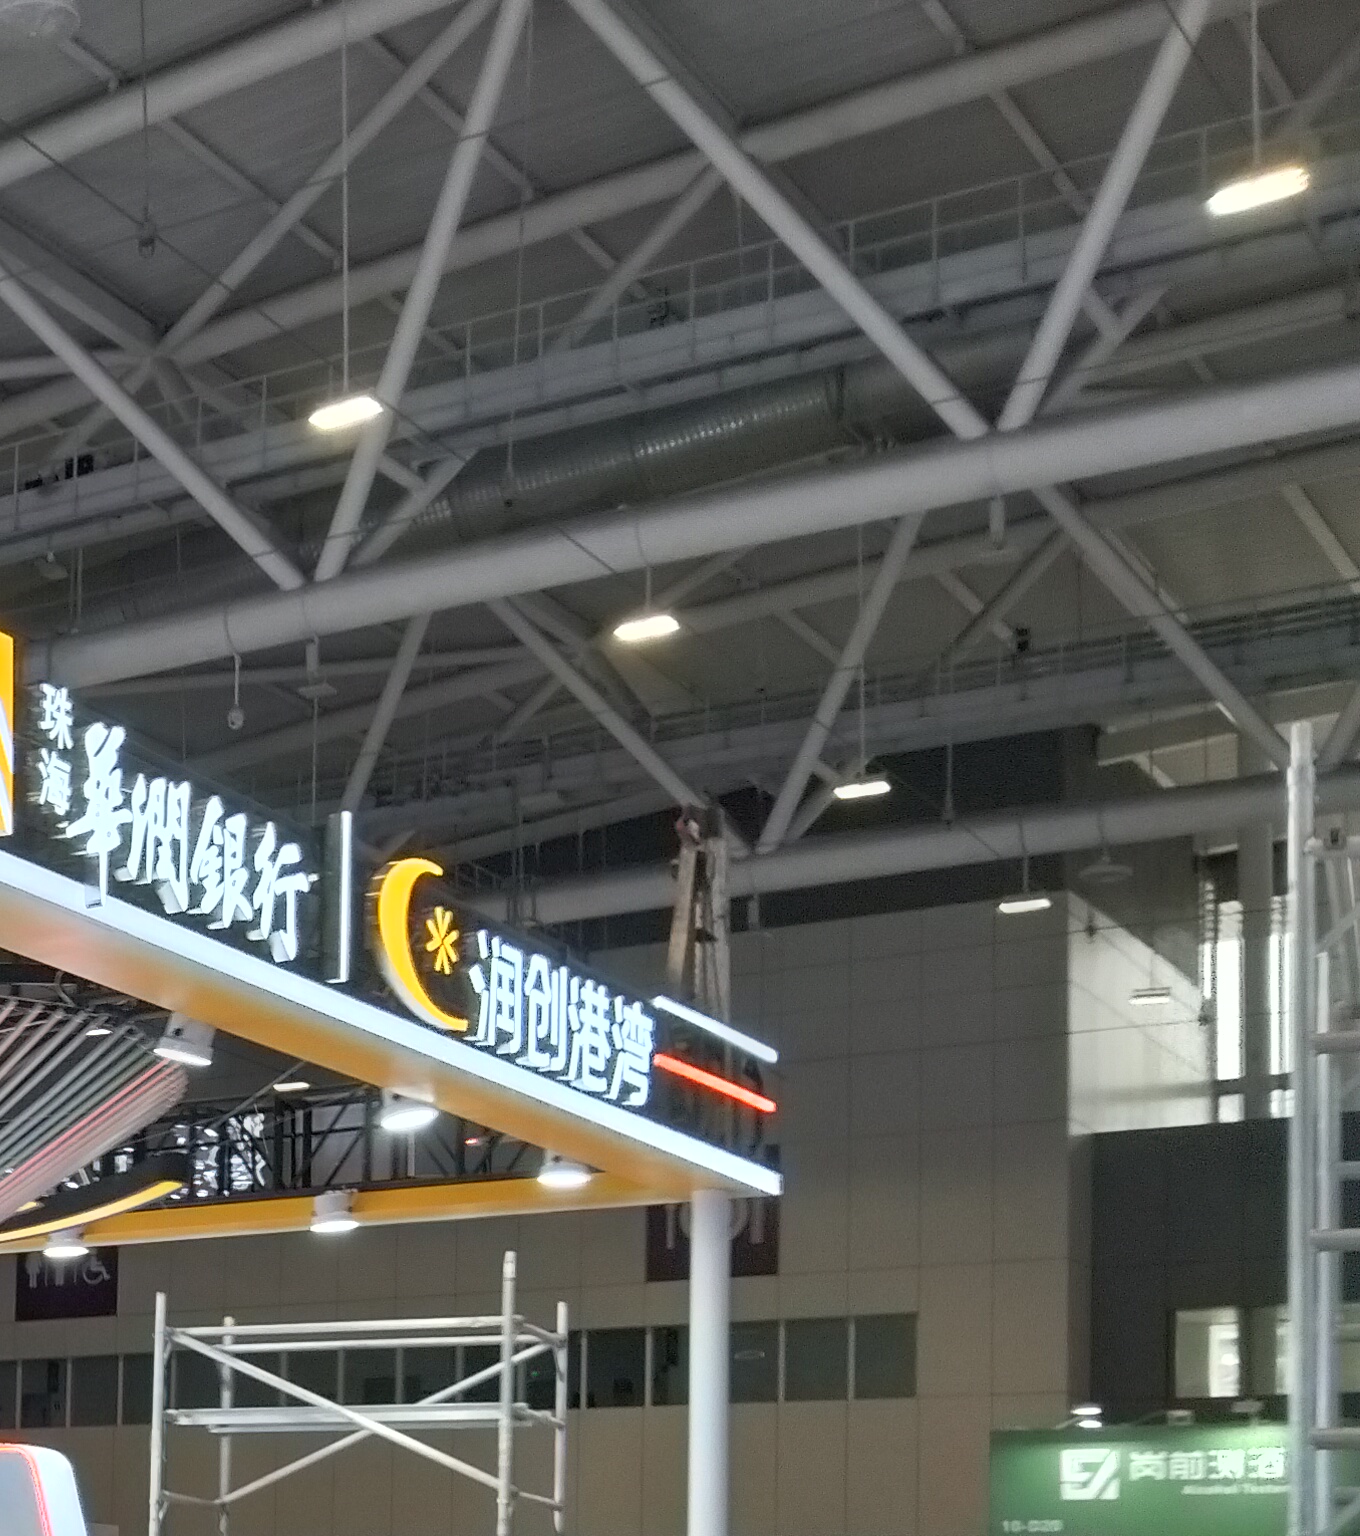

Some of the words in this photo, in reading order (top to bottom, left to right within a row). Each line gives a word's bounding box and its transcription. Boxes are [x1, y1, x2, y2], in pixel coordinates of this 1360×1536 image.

[39, 682, 74, 816] 珠海
[465, 929, 657, 1107] 润创港湾
